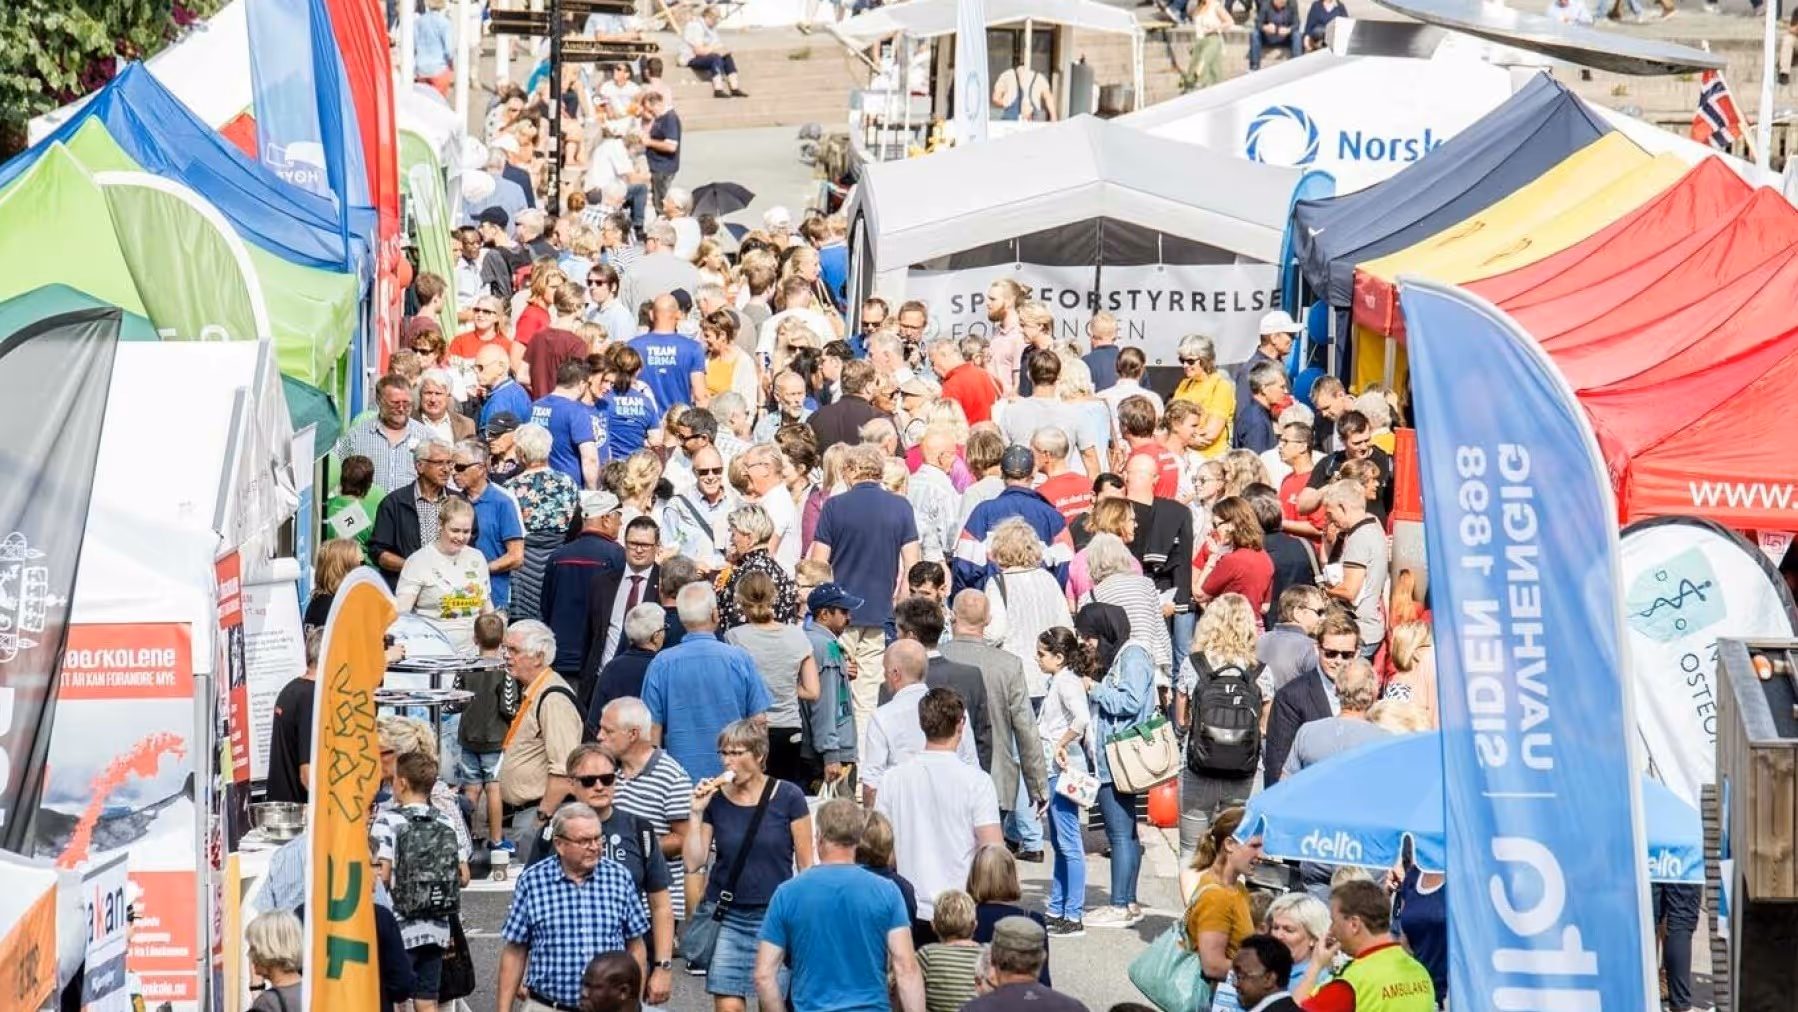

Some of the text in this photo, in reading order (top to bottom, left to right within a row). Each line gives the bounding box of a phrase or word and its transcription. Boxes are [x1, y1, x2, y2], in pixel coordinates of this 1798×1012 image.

[647, 346, 677, 357] TEAM
[647, 356, 677, 366] ERNA
[613, 396, 644, 408] TEAM
[106, 671, 154, 687] FORANDRE
[155, 671, 176, 686] MYE
[1300, 828, 1363, 861] delta
[88, 884, 124, 943] akan
